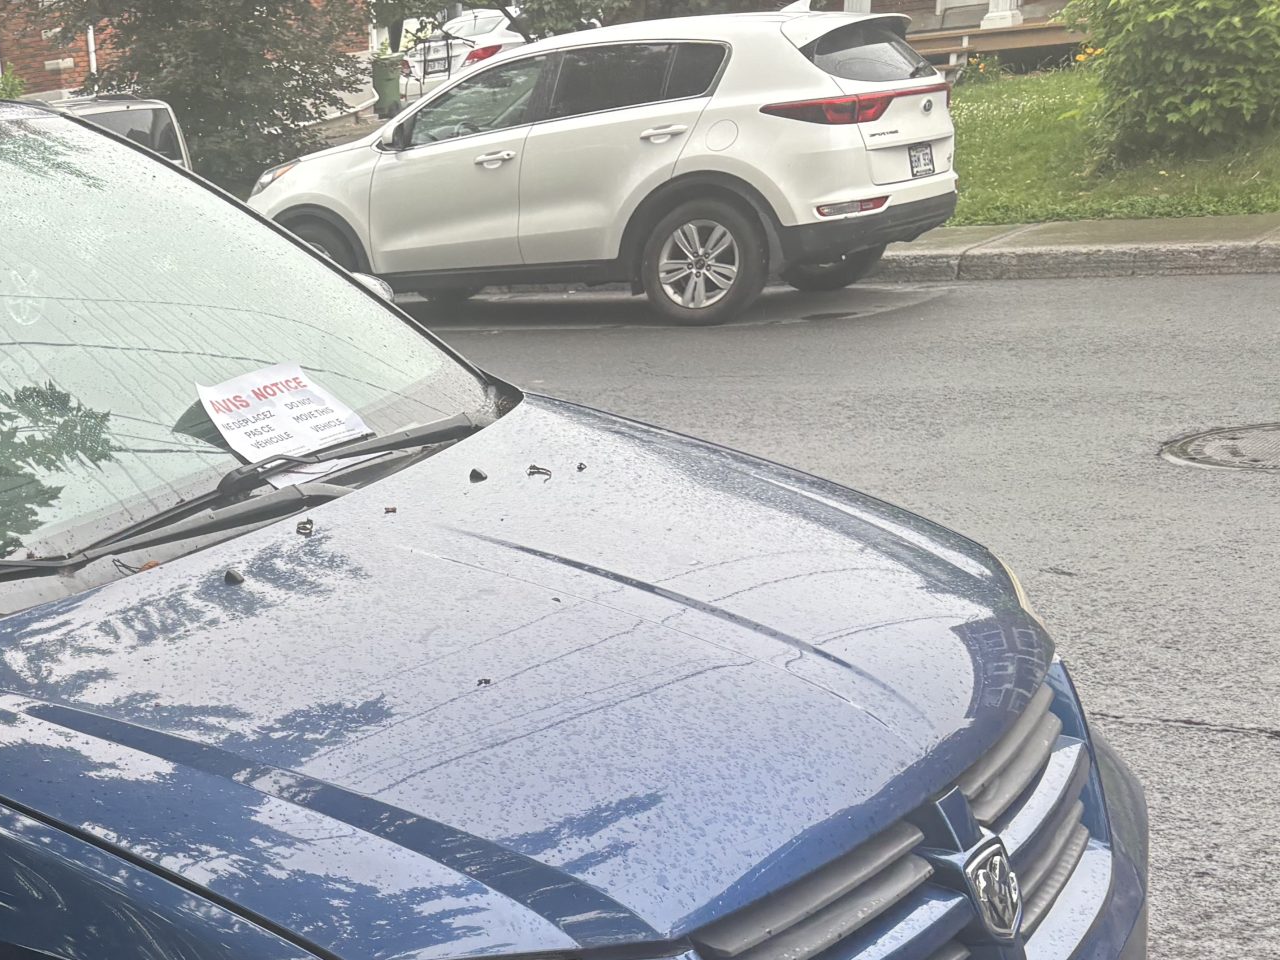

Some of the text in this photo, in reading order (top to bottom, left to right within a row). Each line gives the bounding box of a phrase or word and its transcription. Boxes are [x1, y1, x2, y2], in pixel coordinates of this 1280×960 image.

[210, 377, 308, 415] AVIS NOTICE
[284, 397, 313, 411] DO NOT
[222, 410, 276, 431] NE DÉPLACEZ
[291, 406, 335, 424] MOVE THIS
[244, 424, 276, 440] PAS CE
[309, 418, 346, 434] VEHICLE
[250, 431, 294, 450] VÉHICULE
